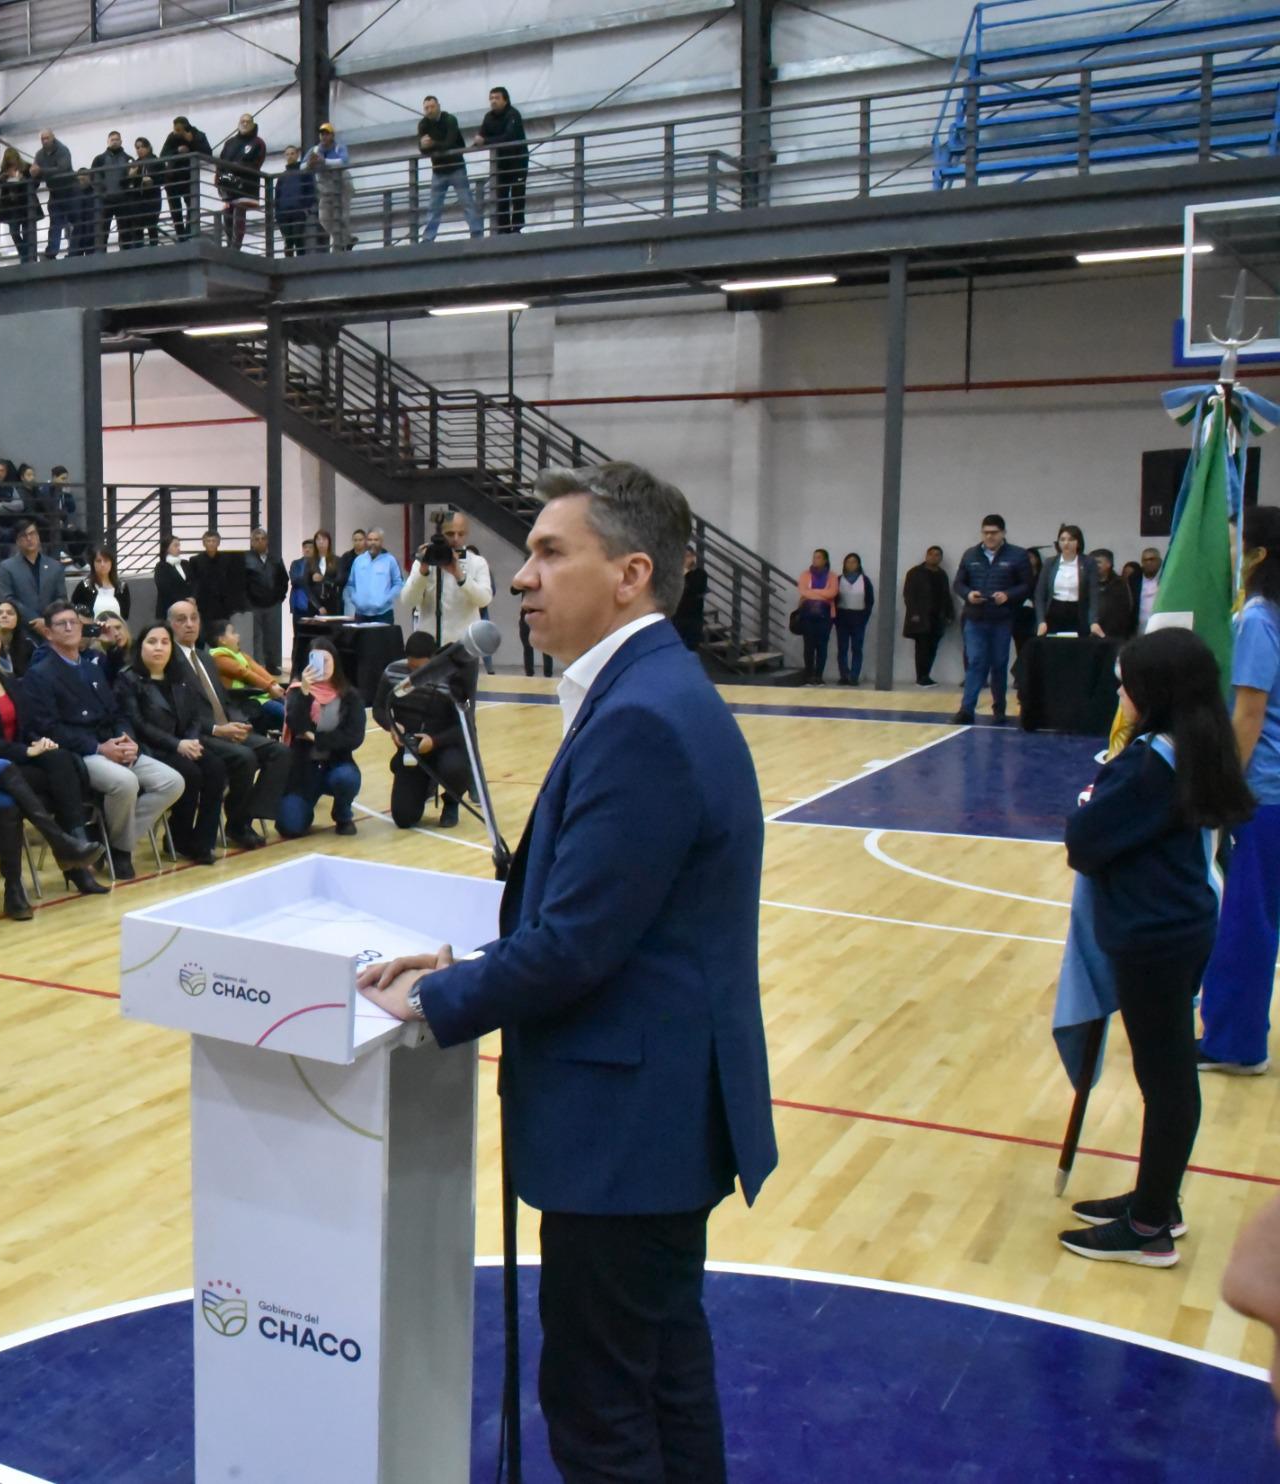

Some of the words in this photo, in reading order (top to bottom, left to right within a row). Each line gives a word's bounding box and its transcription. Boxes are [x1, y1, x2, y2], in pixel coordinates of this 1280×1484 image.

[212, 981, 271, 1004] CHACO
[258, 1300, 302, 1320] Gobierno
[304, 1313, 319, 1325] del
[258, 1316, 361, 1362] CHACO
